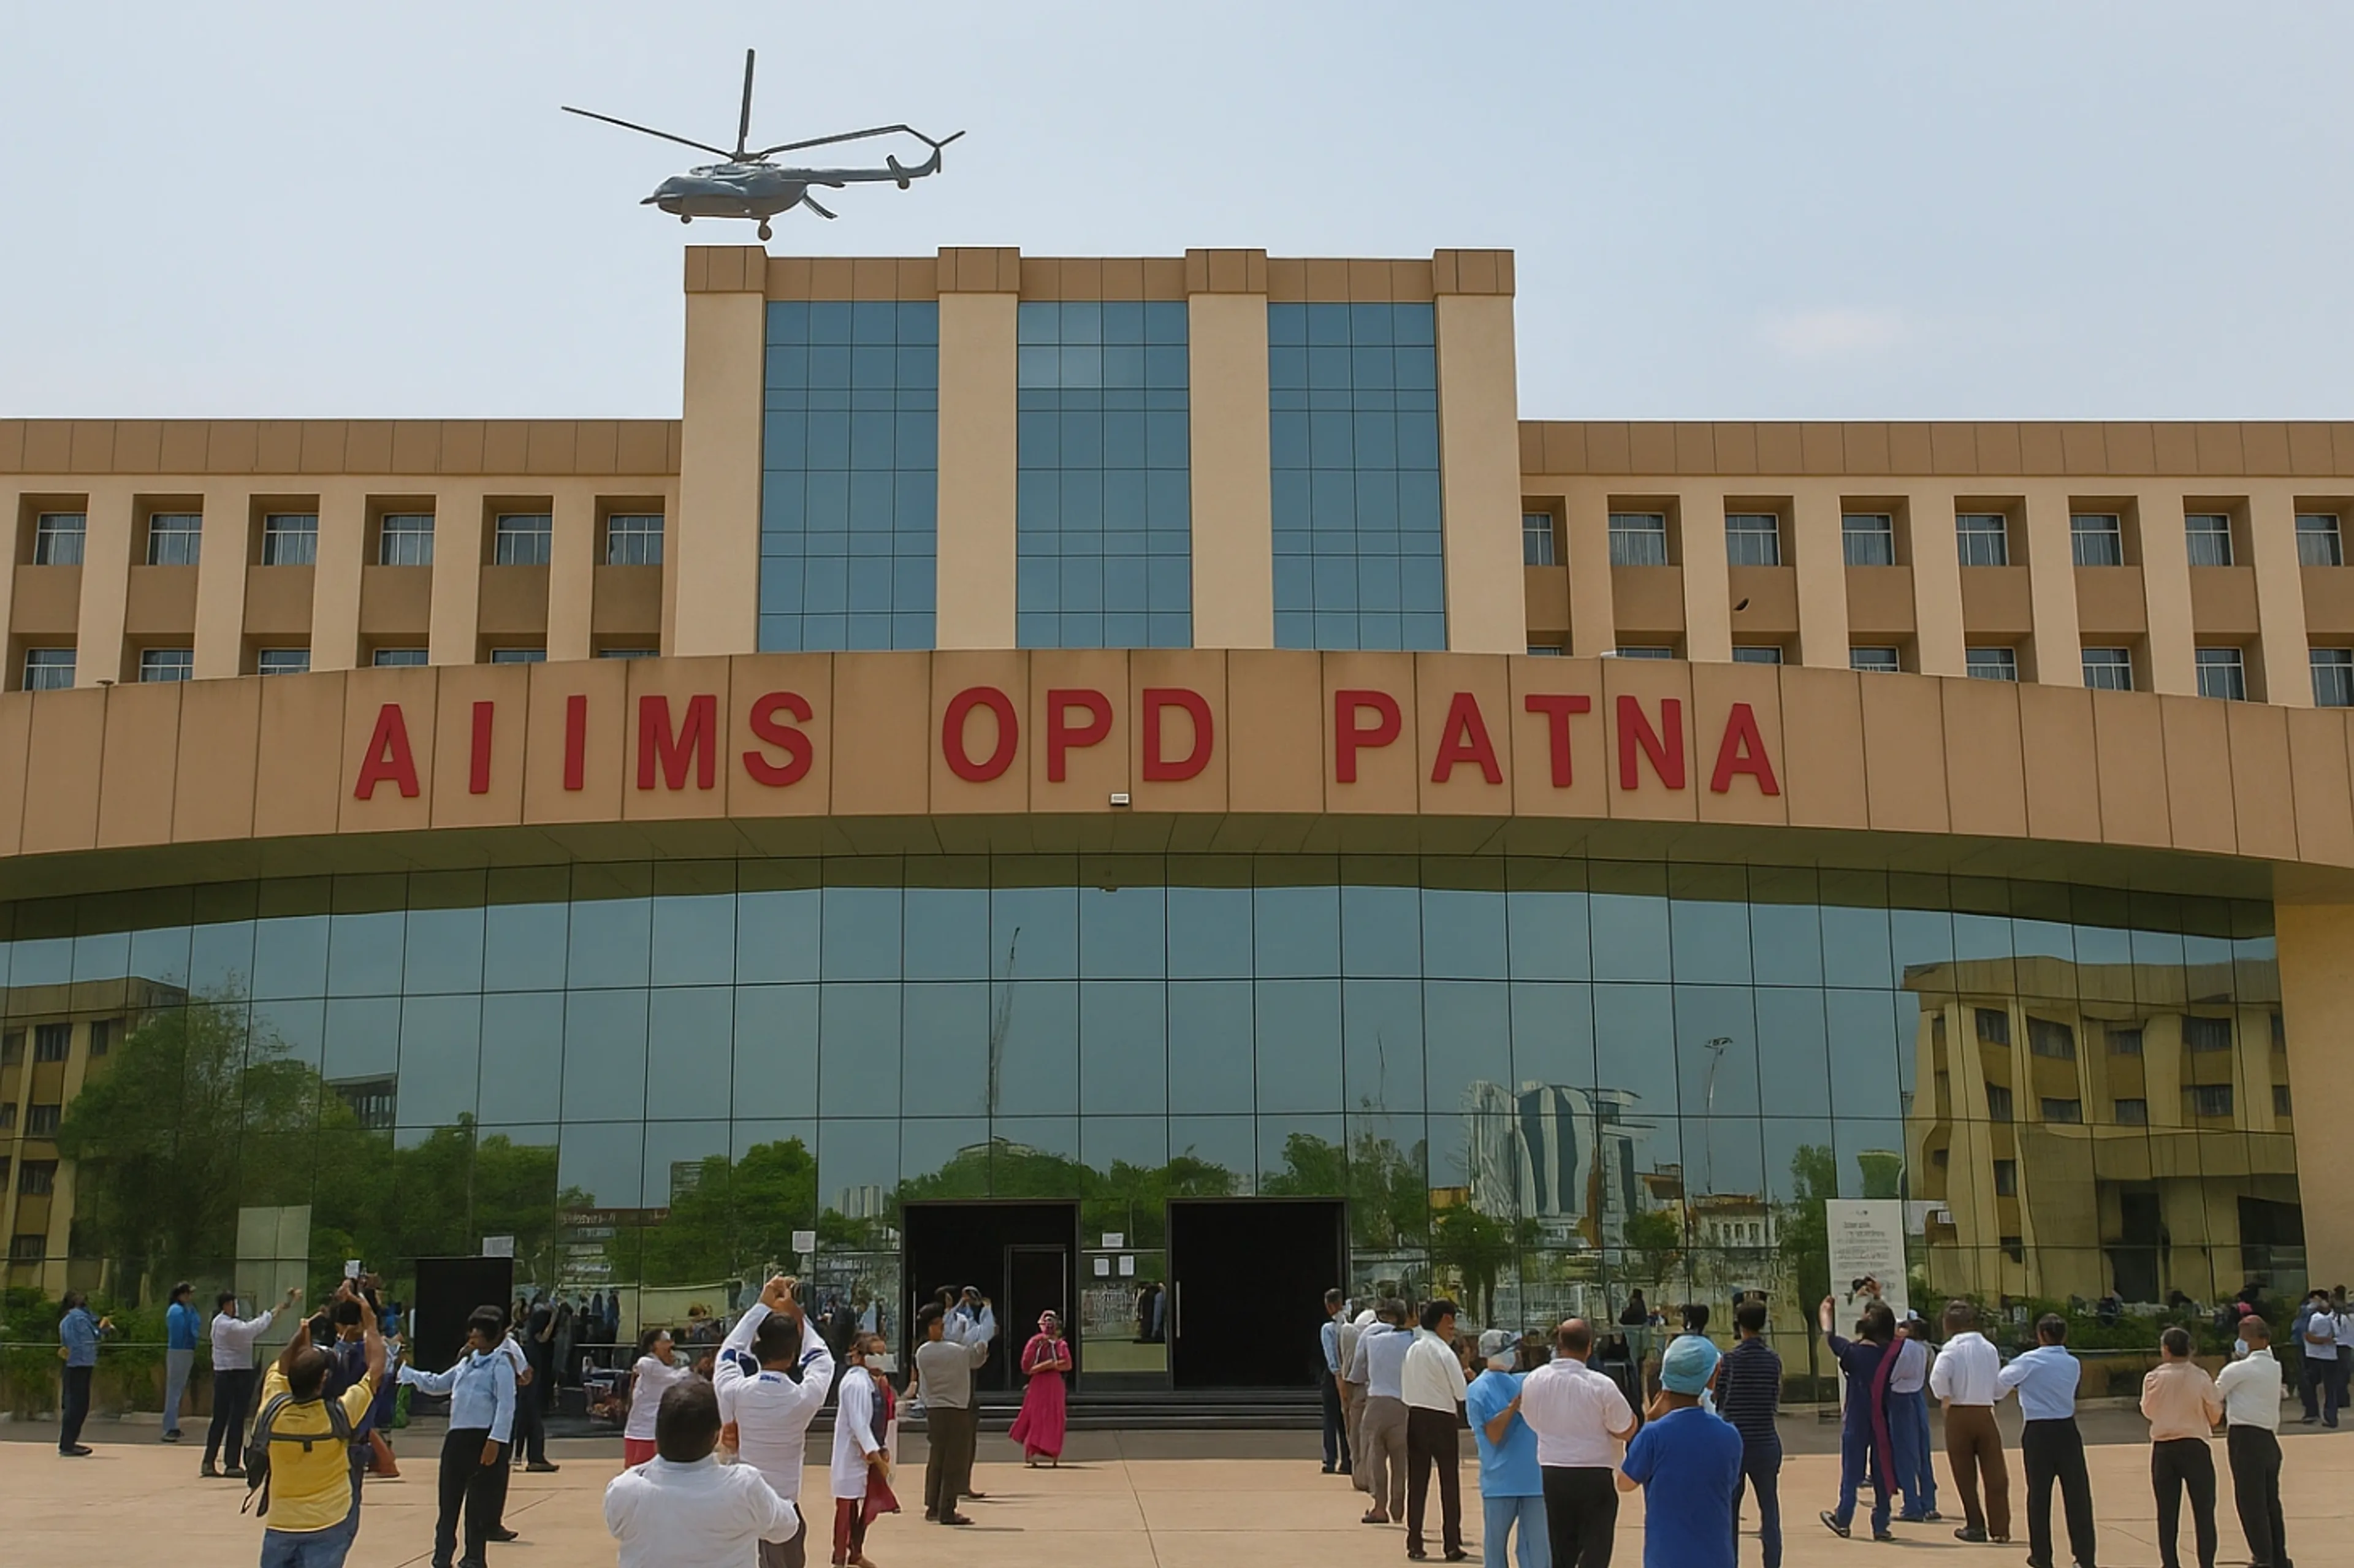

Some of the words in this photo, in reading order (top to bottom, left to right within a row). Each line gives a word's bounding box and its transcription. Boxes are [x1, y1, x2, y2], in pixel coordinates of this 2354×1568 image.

[354, 692, 813, 799] AIIMS
[942, 687, 1214, 782] OPD
[1335, 690, 1779, 796] PATNA
